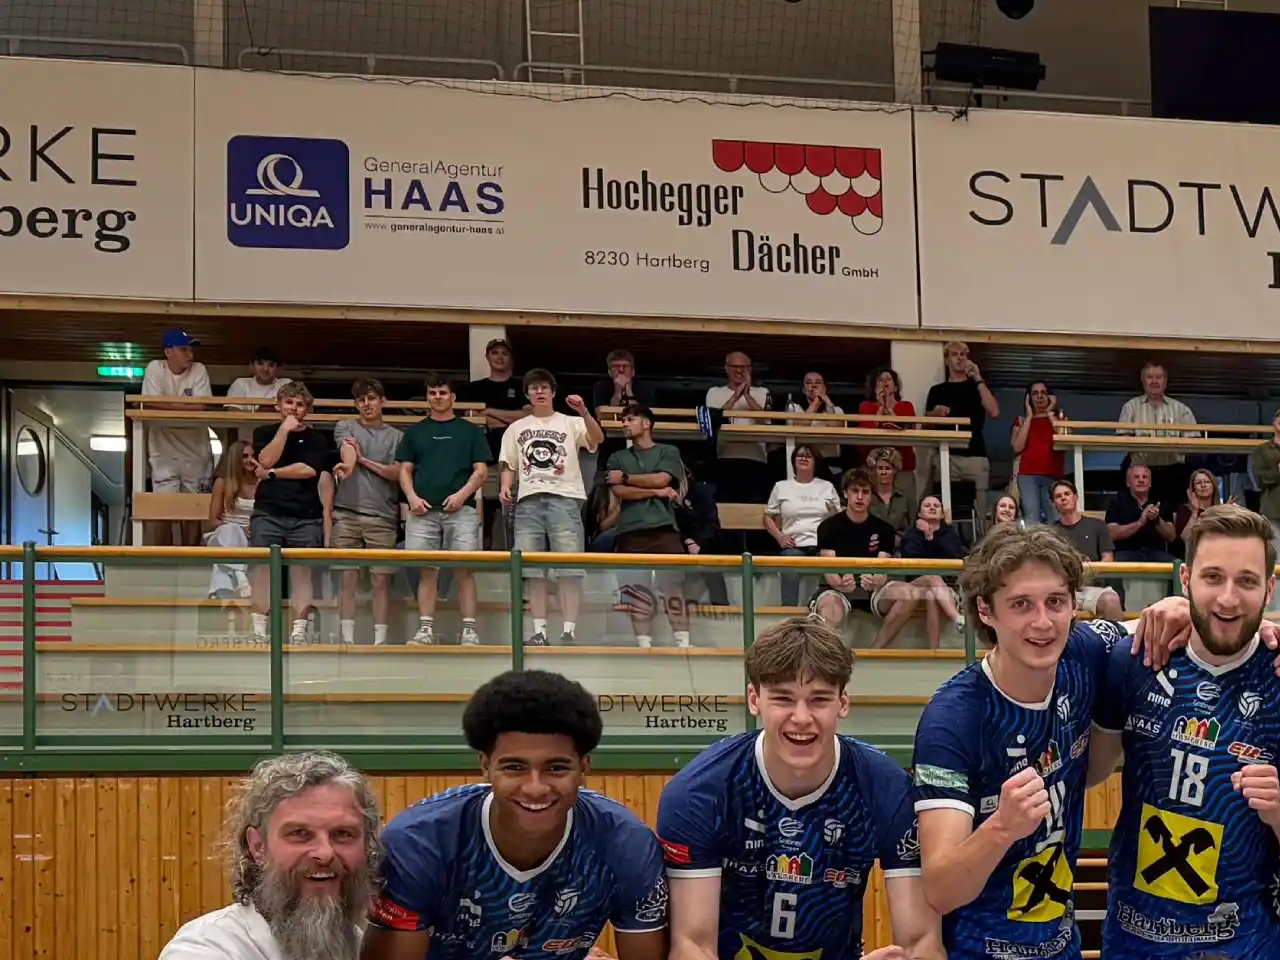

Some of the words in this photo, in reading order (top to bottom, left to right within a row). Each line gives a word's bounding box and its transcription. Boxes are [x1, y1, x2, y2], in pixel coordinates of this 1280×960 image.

[364, 156, 503, 179] GeneralAgentur
[364, 177, 505, 215] HAAS
[582, 166, 744, 227] Hochegger
[230, 201, 334, 229] UNIQA
[584, 250, 629, 268] 8230
[636, 252, 711, 273] Hartberg
[731, 229, 840, 276] Dächer
[842, 266, 879, 279] GmbH
[61, 693, 256, 717] STADTWERKE
[598, 694, 728, 713] DTWERKE
[1147, 691, 1172, 708] nine
[166, 714, 256, 731] Hartberg
[645, 715, 728, 732] Hartberg
[1169, 748, 1209, 807] 18
[770, 891, 798, 939] 6
